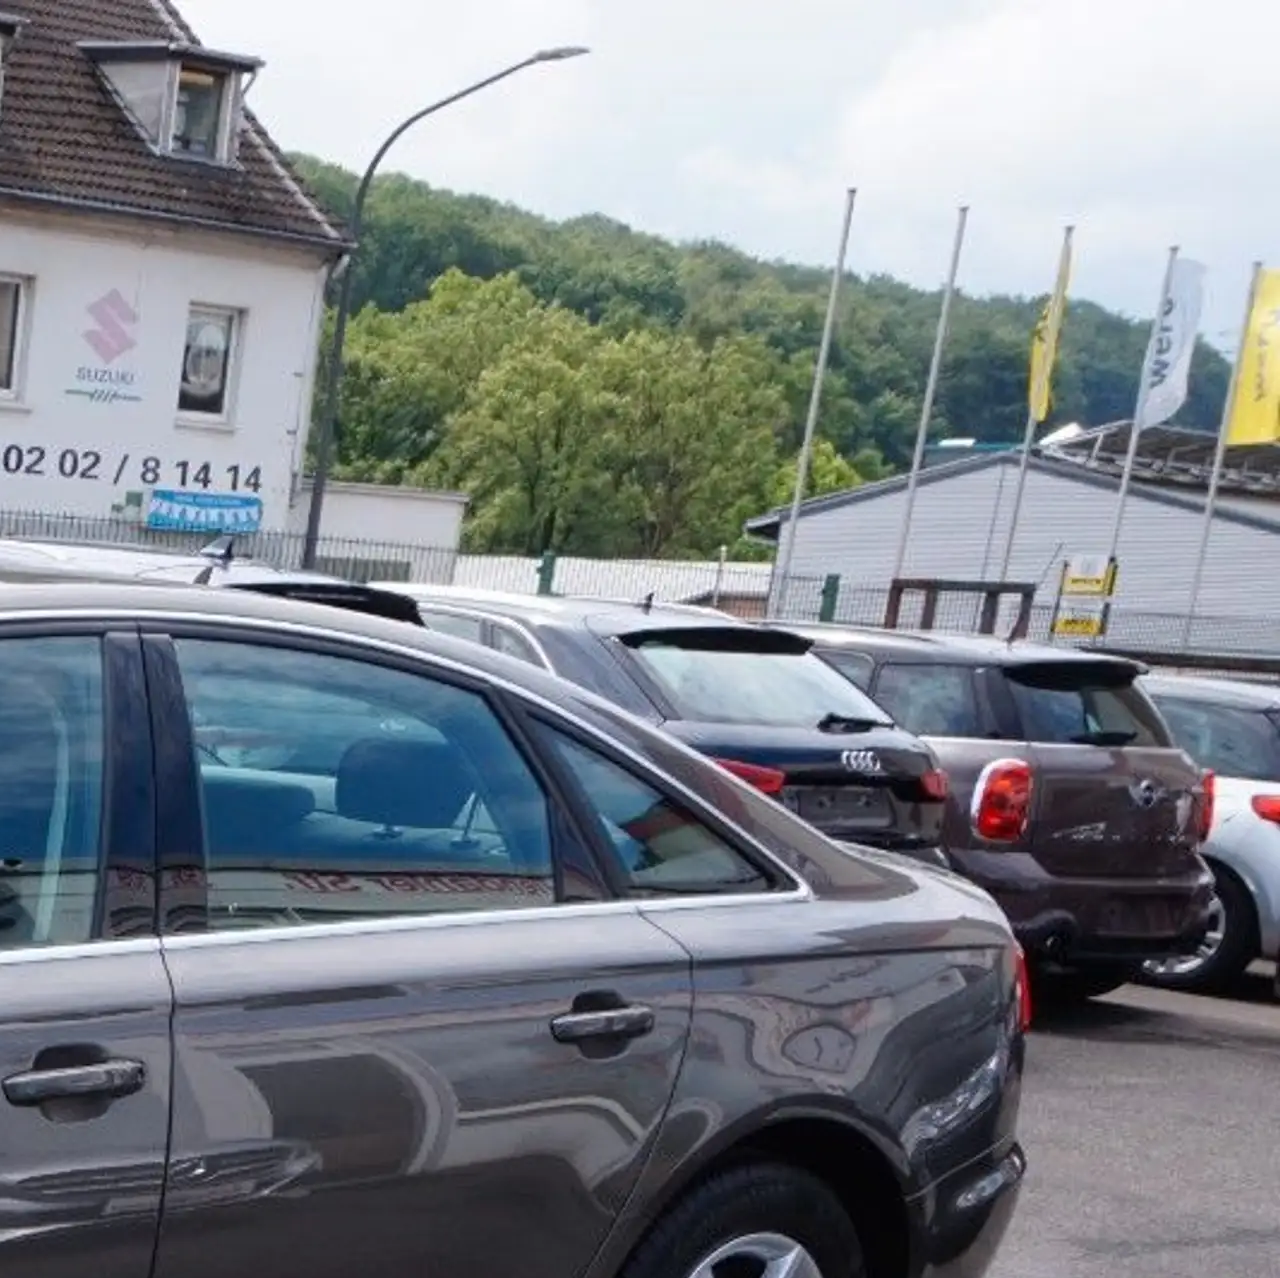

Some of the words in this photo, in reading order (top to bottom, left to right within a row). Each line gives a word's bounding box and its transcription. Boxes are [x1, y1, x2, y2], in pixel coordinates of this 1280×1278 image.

[75, 366, 137, 385] SUZUKI
[3, 444, 46, 475] 02
[58, 449, 101, 480] 02
[112, 454, 129, 485] /
[140, 456, 161, 485] 8
[175, 460, 212, 489] 14
[226, 464, 262, 492] 14
